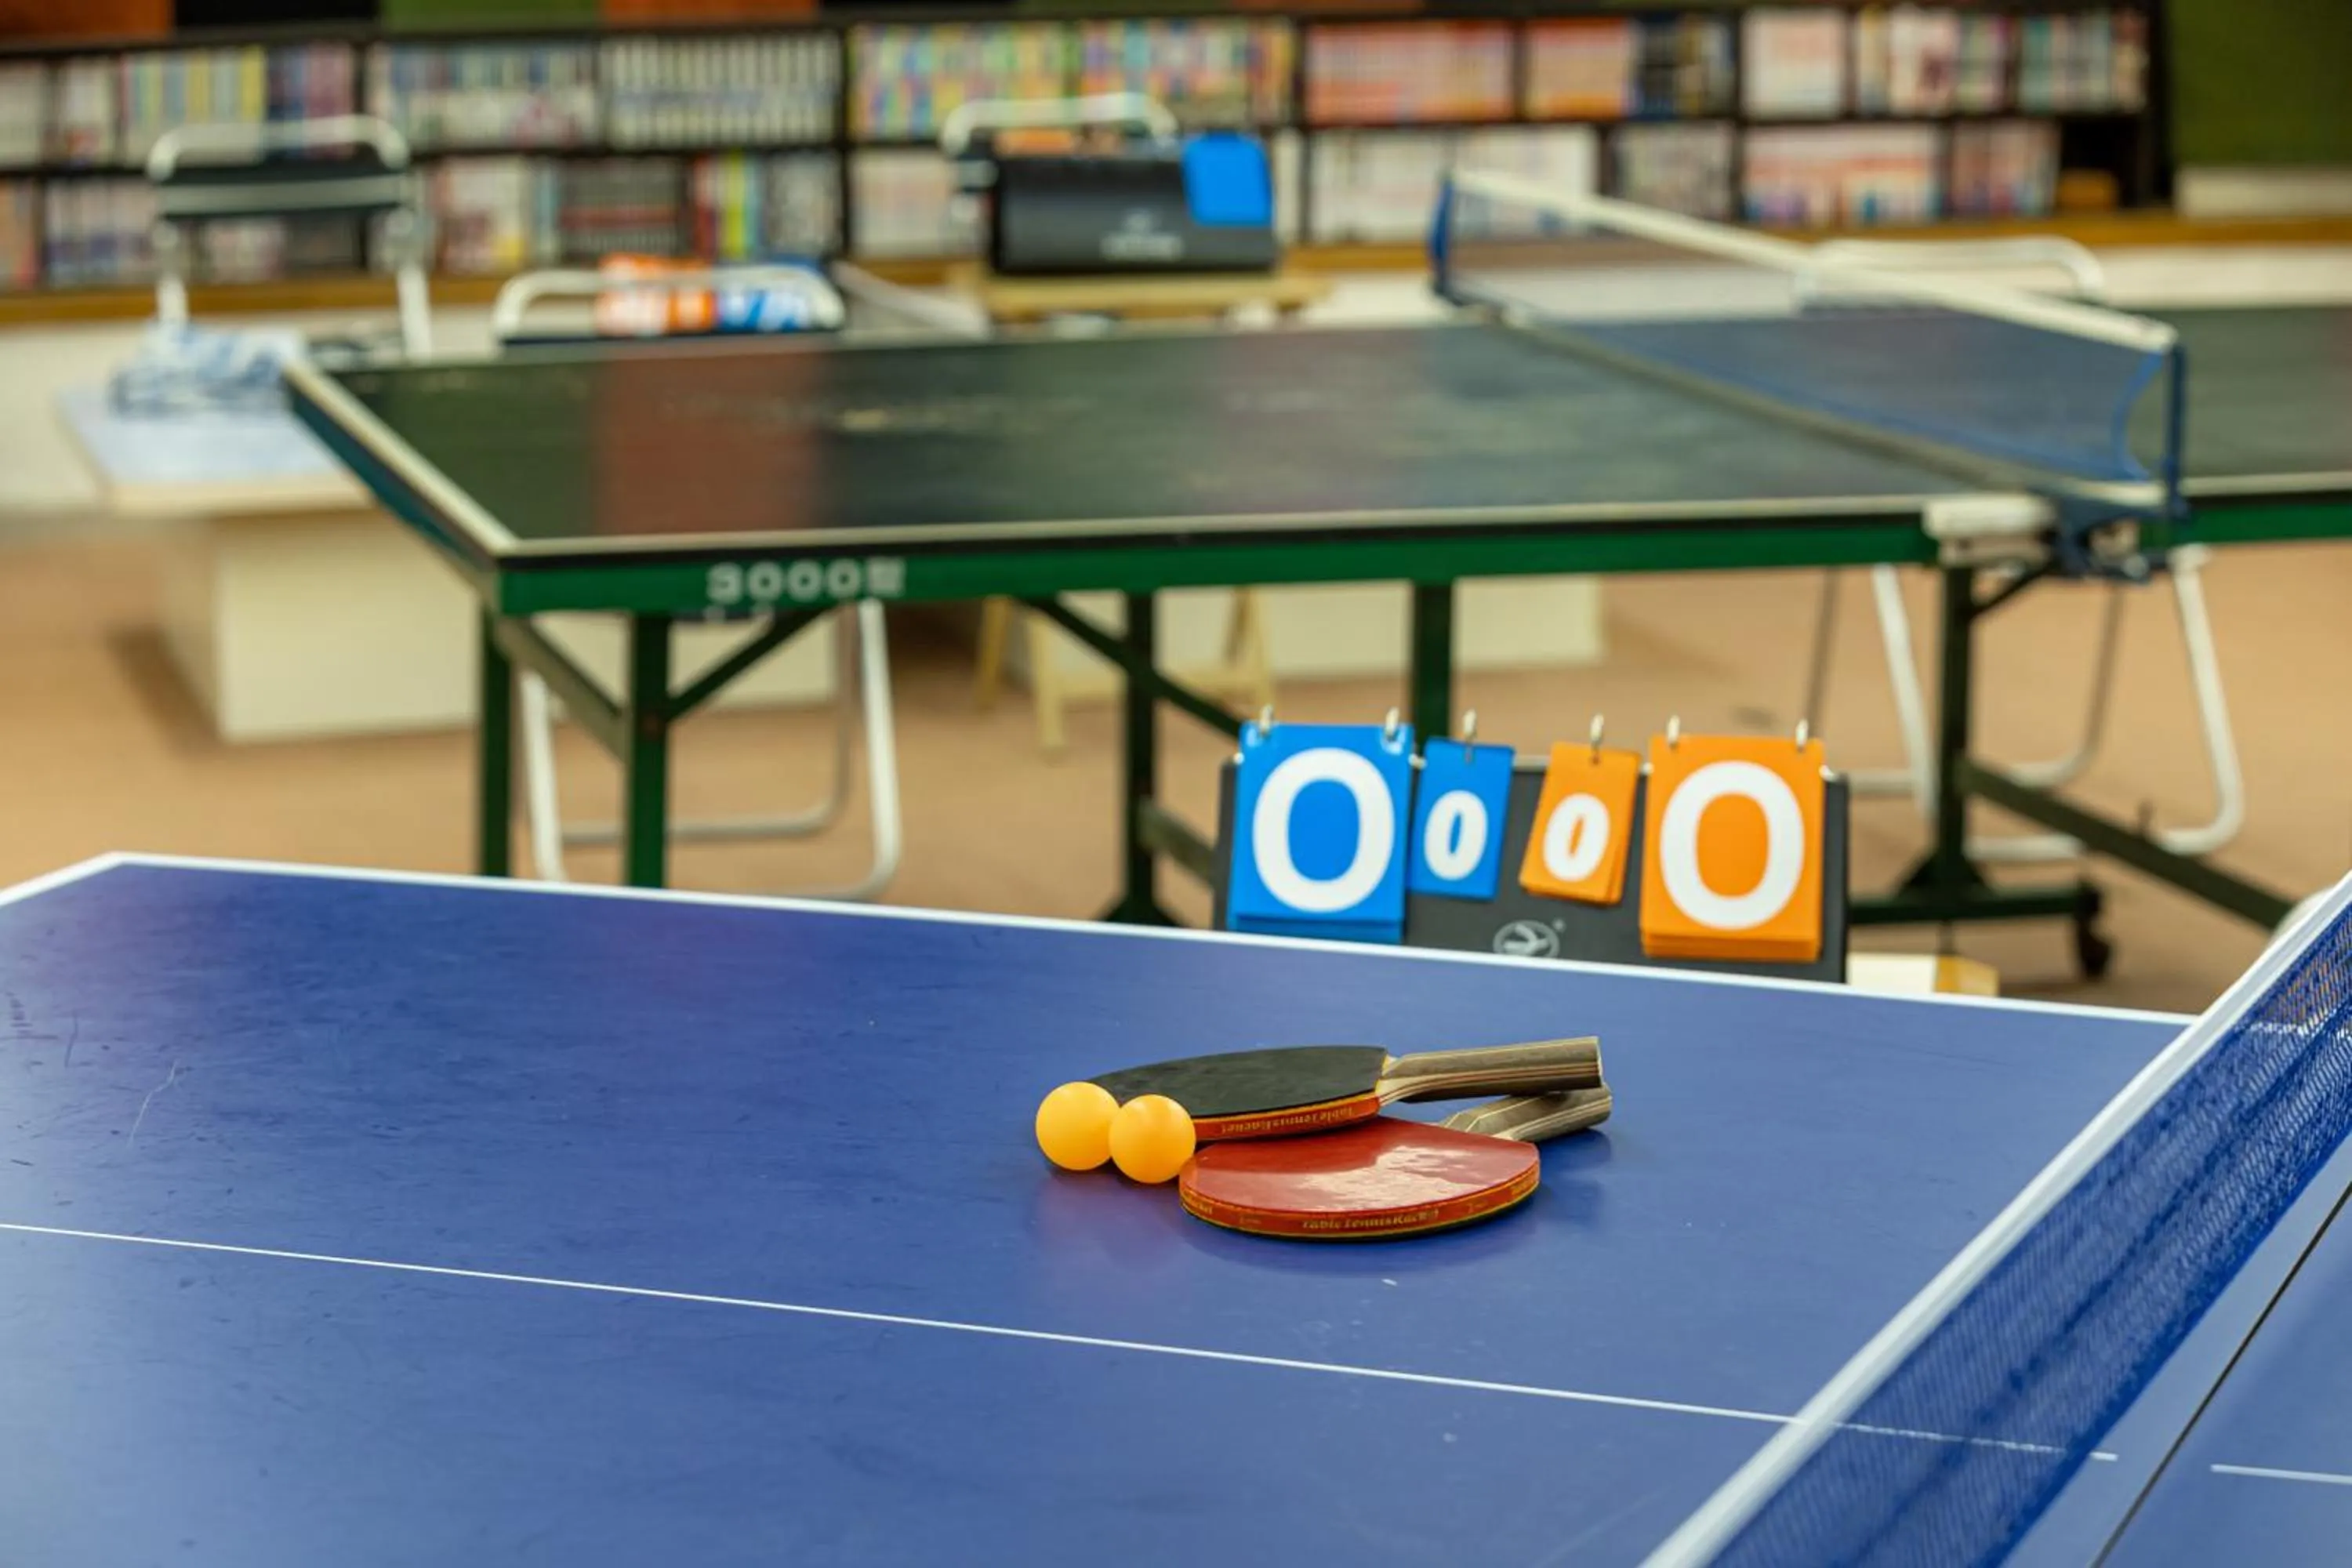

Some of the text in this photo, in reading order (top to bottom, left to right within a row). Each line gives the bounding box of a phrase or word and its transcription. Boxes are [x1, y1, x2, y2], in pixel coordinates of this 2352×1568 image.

[1254, 749, 1393, 911] 0
[1425, 791, 1486, 879] 0
[1544, 794, 1609, 881] 0
[1661, 761, 1803, 929] 0
